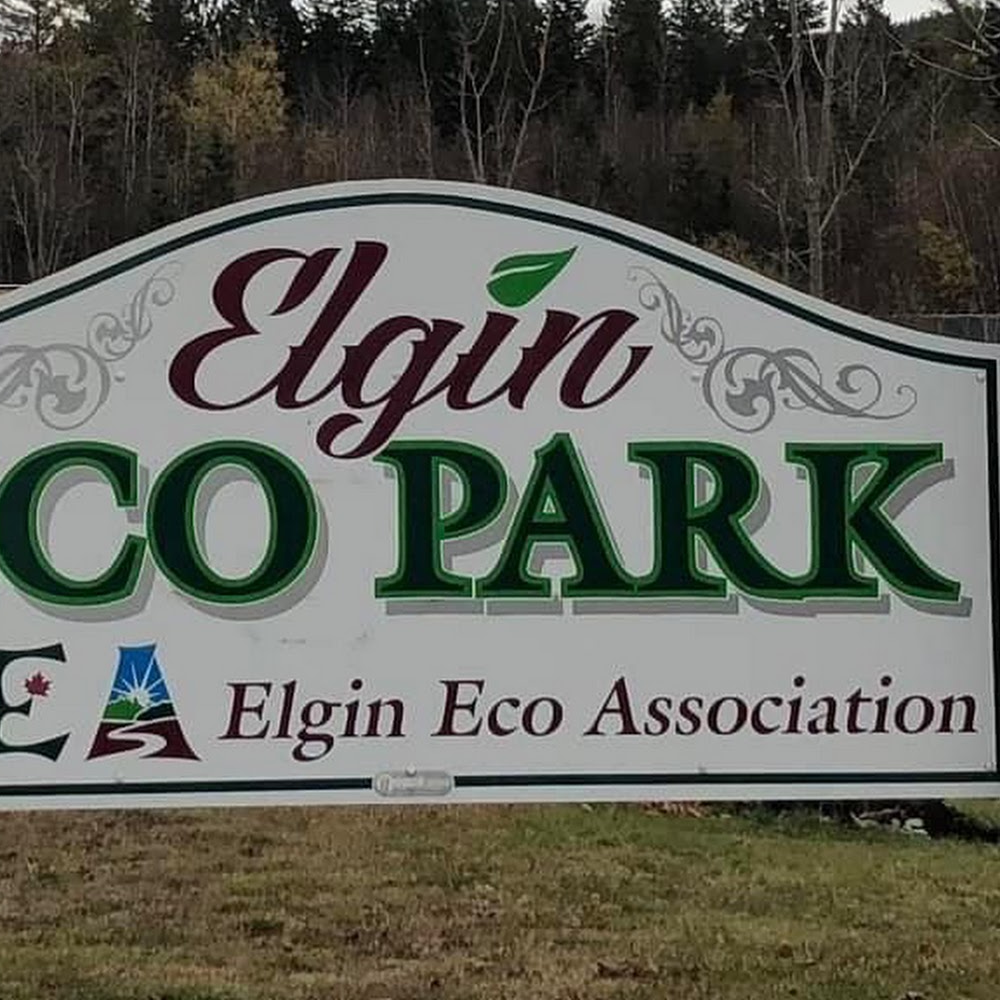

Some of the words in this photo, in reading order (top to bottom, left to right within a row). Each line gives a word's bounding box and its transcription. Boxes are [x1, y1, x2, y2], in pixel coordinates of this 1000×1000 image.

[168, 240, 653, 459] Elgin
[373, 432, 962, 603] PARK
[217, 678, 406, 762] Elgin
[429, 679, 564, 737] Eco
[582, 675, 979, 737] Association
